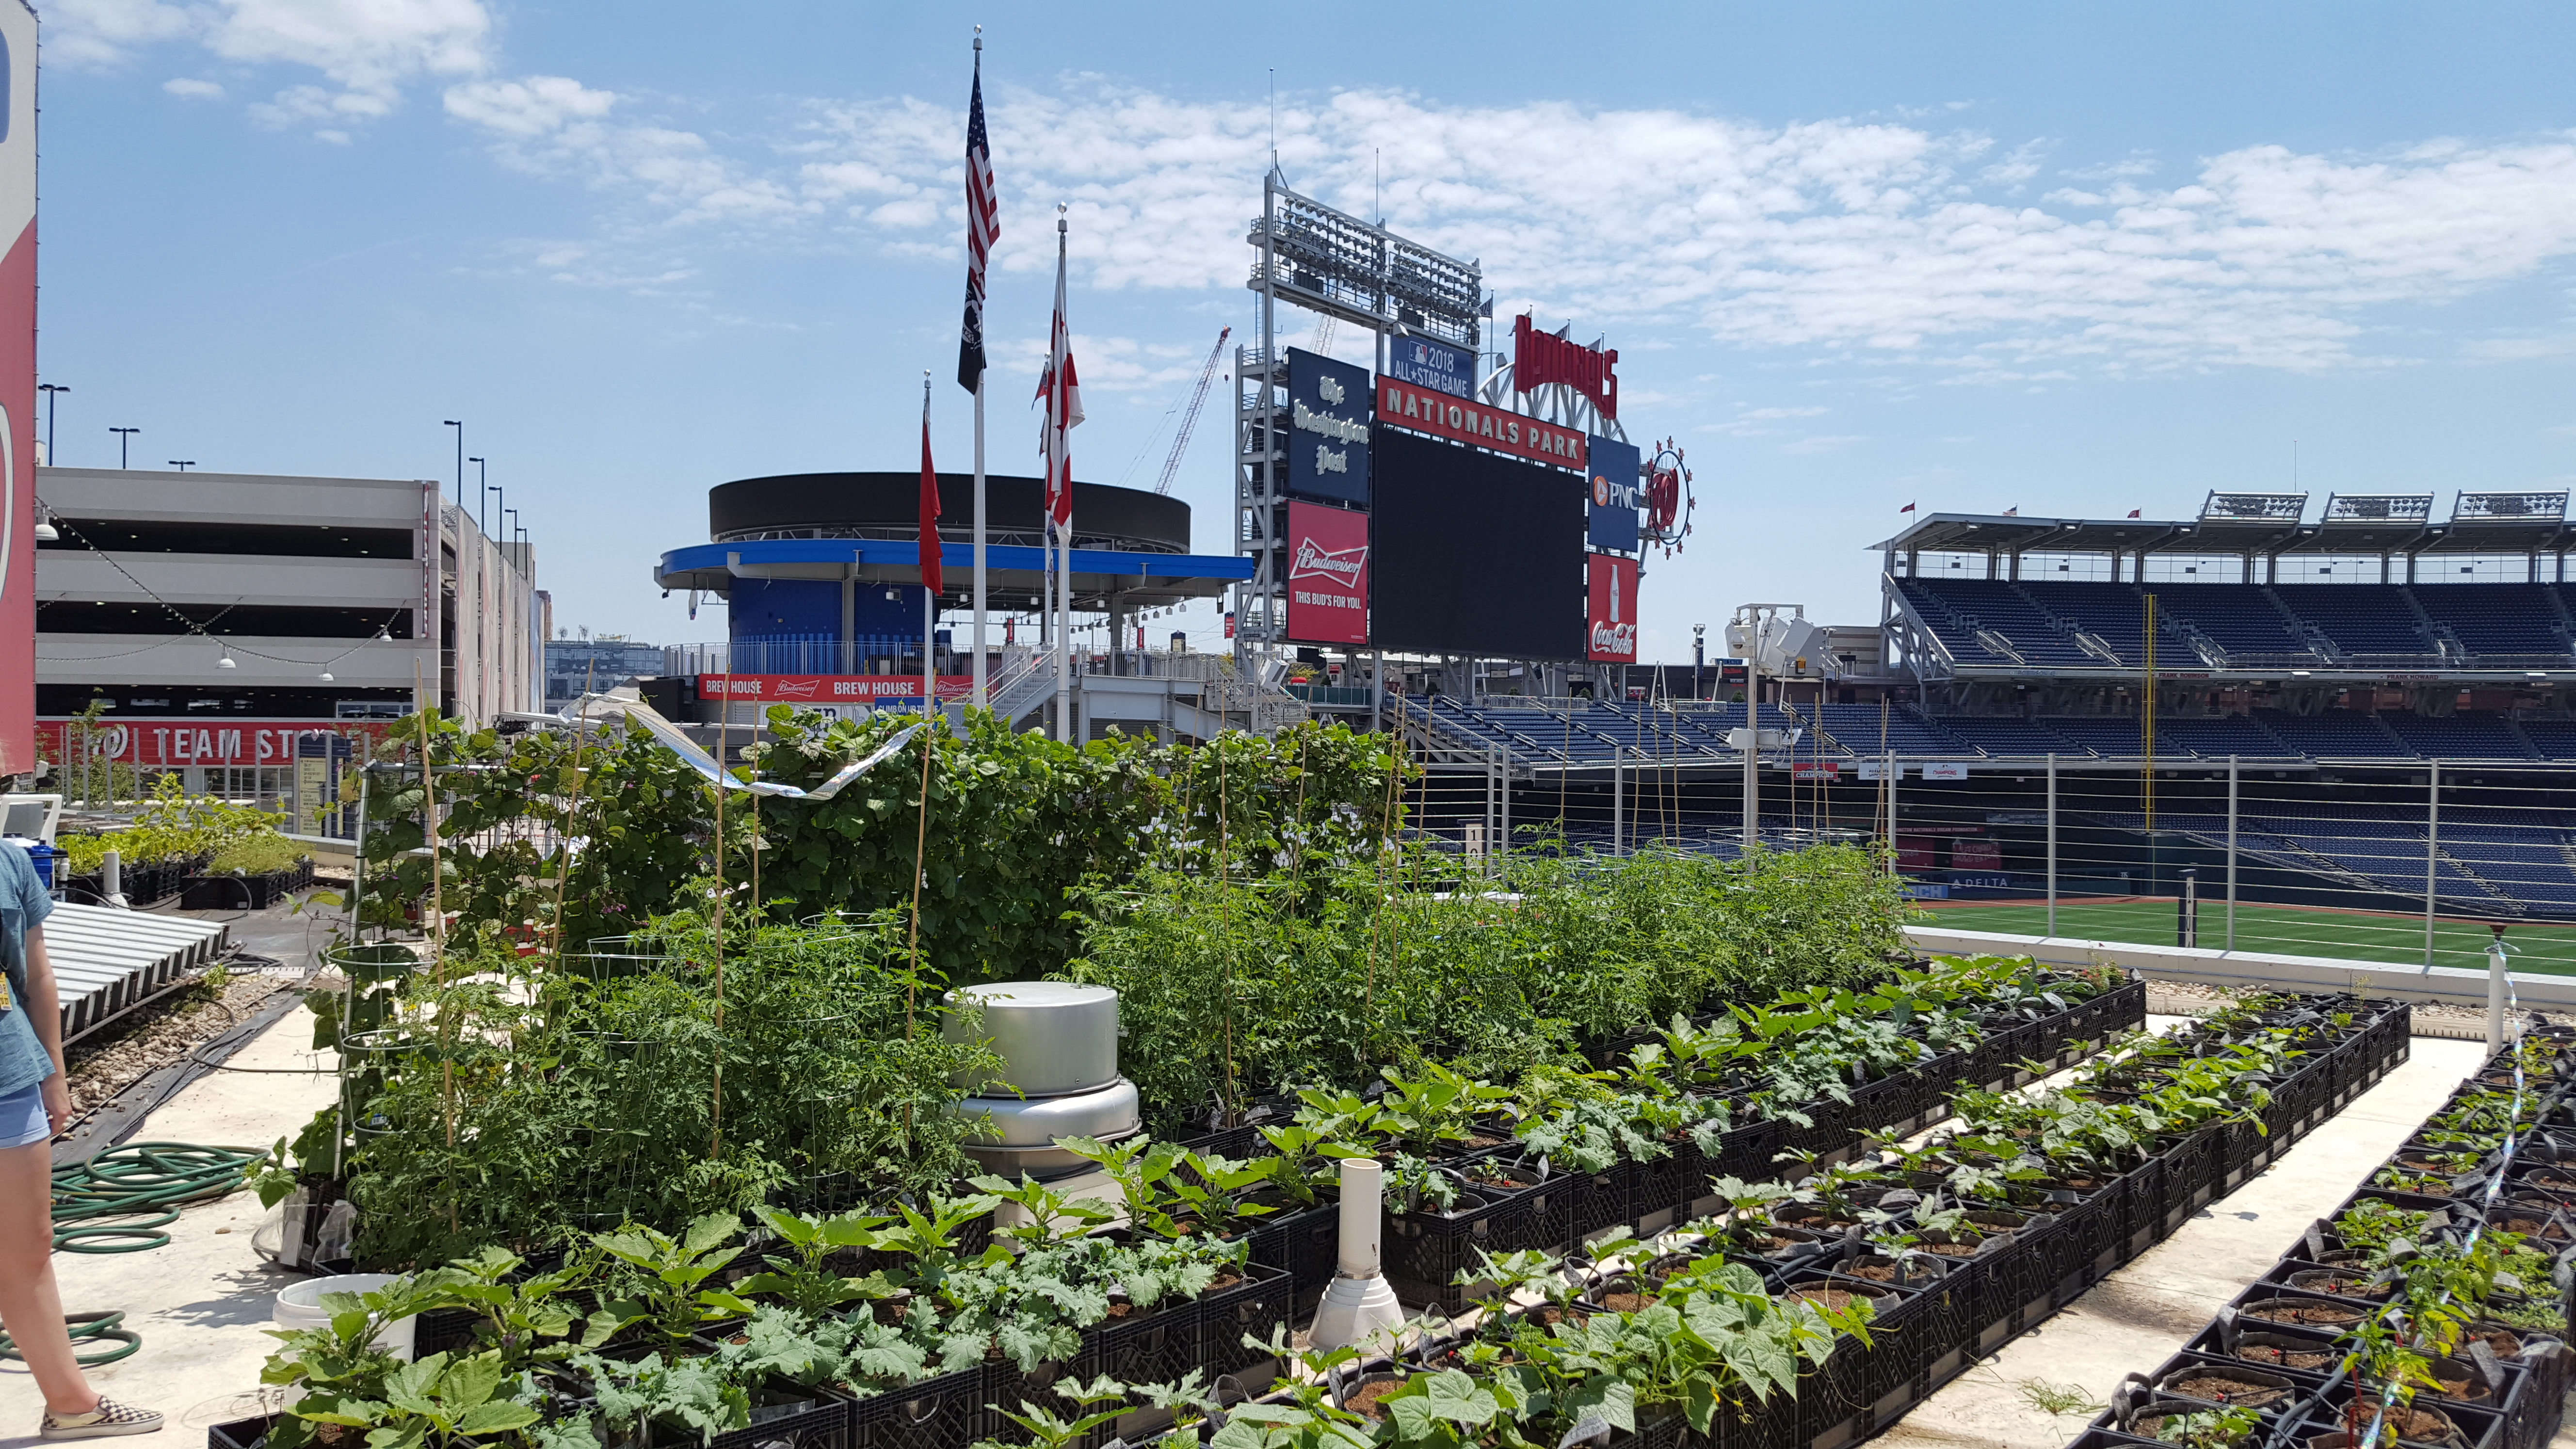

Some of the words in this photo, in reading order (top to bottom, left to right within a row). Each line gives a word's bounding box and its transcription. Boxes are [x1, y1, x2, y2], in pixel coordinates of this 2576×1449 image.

[1429, 347, 1454, 373] 2018
[1514, 314, 1618, 420] NATIONALS
[1320, 376, 1345, 406] The
[1395, 360, 1411, 382] ALL
[1417, 367, 1440, 390] STAR
[1442, 374, 1467, 397] GAME
[1293, 398, 1369, 445] Washington
[1387, 388, 1519, 444] NATIONALS
[1528, 427, 1578, 460] PARK
[1316, 444, 1347, 475] Post
[1608, 482, 1639, 511] PNC
[1296, 547, 1360, 573] Budweiser
[1295, 591, 1311, 604] THIS
[1312, 593, 1332, 607] BUD'S
[1333, 595, 1346, 608] FOR
[1347, 597, 1361, 609] YOU.
[731, 681, 762, 694] HOUSE
[777, 681, 815, 692] Budweiser
[834, 682, 869, 694] BREW
[872, 682, 915, 694] HOUSE
[153, 728, 241, 758] TEAM
[260, 729, 362, 757] STE
[1965, 877, 2007, 888] DELTA
